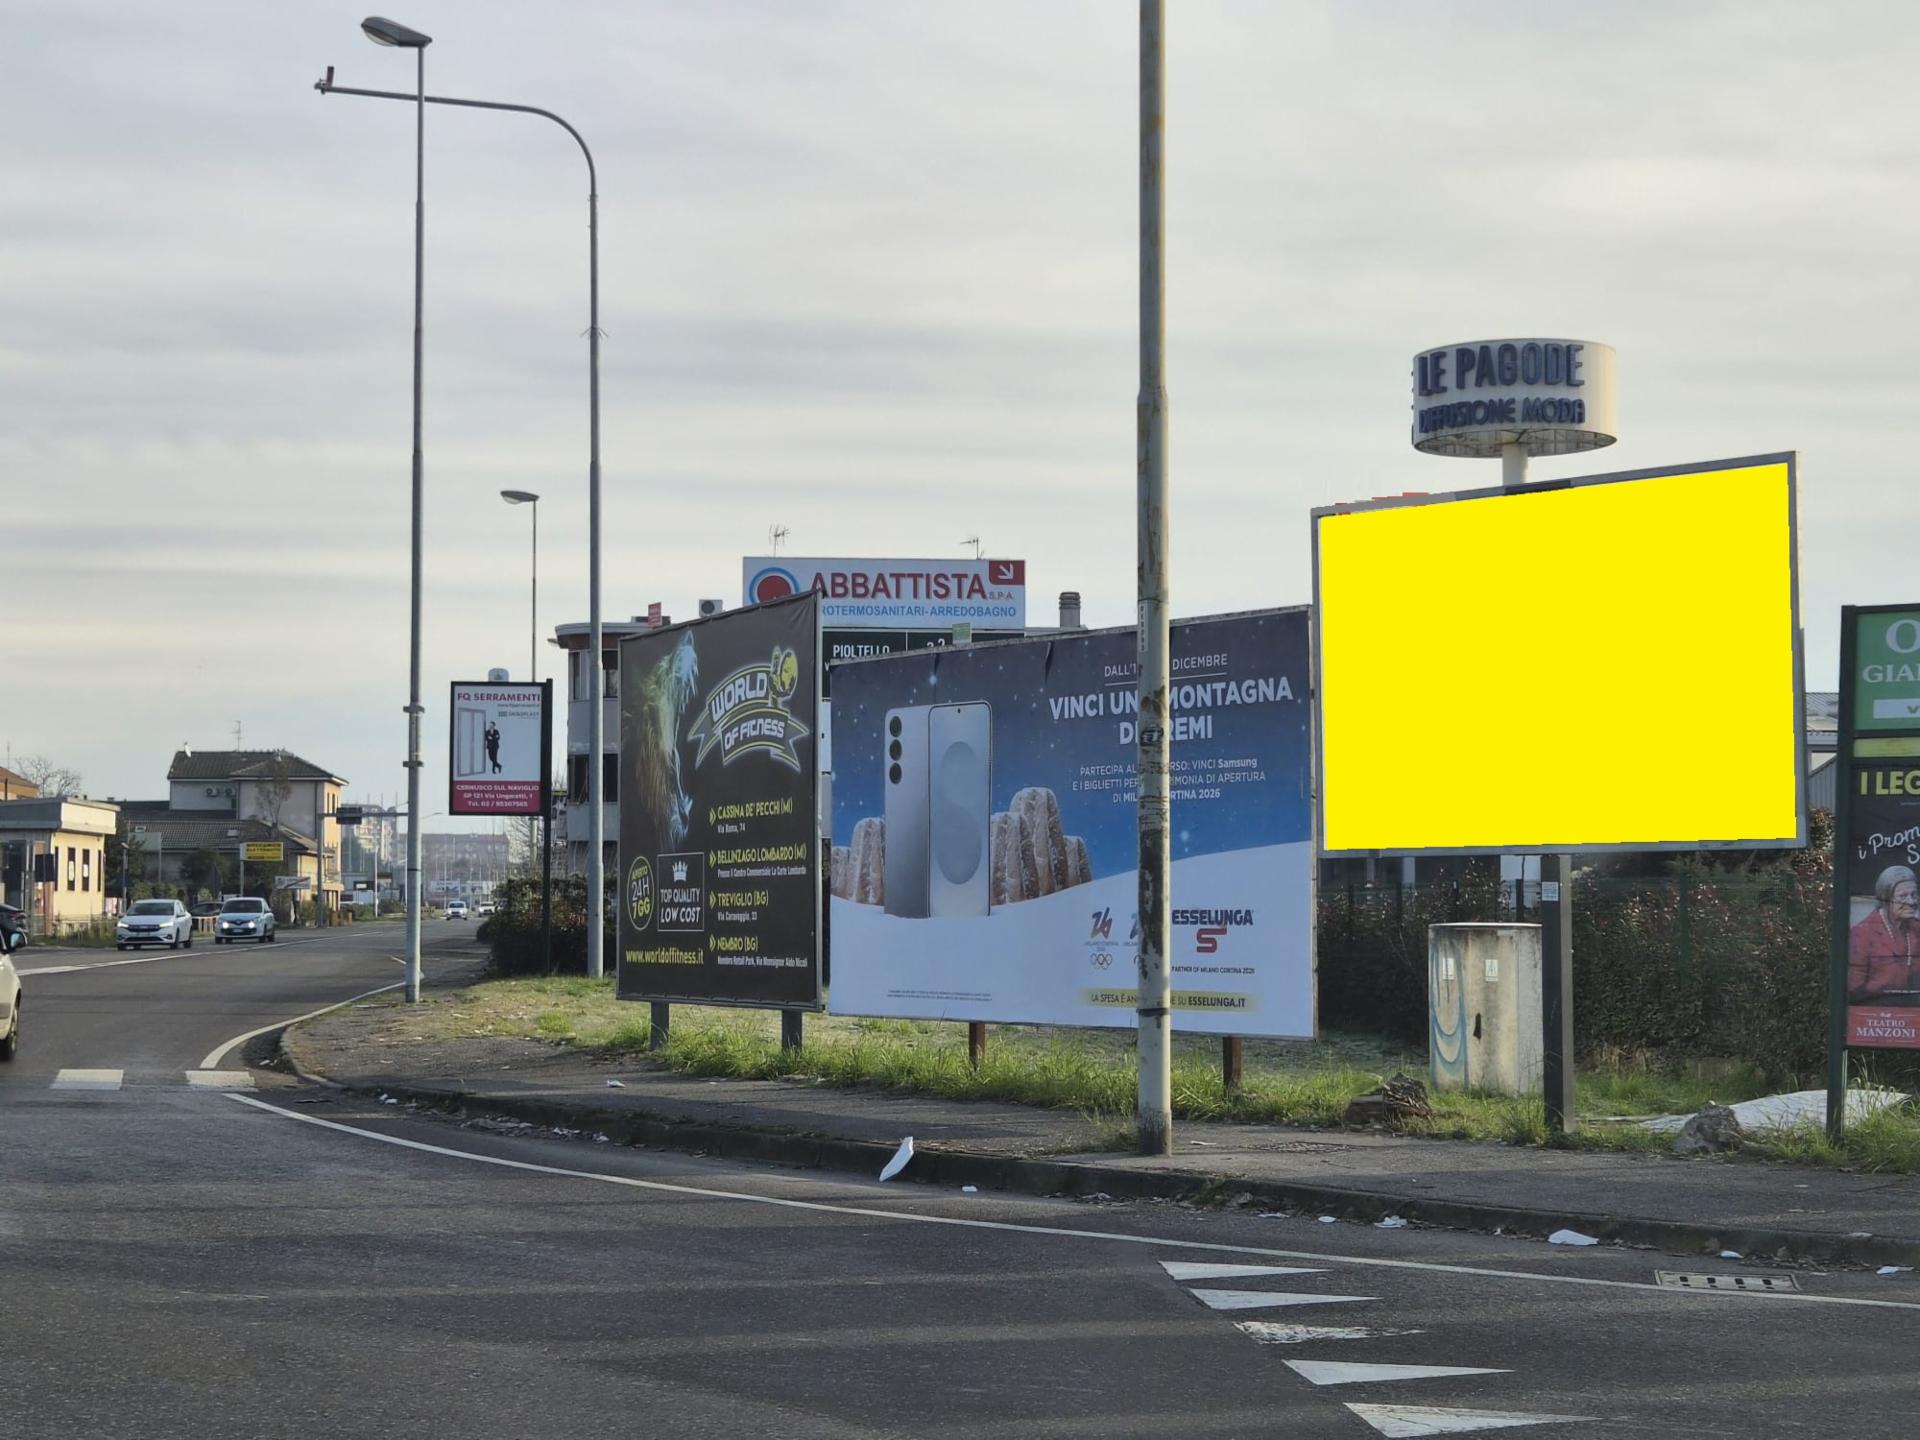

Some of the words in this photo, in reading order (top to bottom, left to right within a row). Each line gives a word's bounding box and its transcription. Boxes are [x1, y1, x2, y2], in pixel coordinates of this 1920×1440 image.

[1418, 351, 1448, 397] LE
[1455, 342, 1585, 390] PAGODE
[1522, 396, 1585, 424] MODA
[811, 572, 987, 600] ABBATTISTA
[822, 604, 1016, 618] ROTERMOSANITARI-ARREDOBAGNO
[1172, 654, 1228, 670] DICEMBRE
[1862, 664, 1920, 683] GIA
[457, 692, 471, 701] FQ
[473, 693, 541, 702] SERRAMENTI
[711, 672, 767, 722] WORLD
[1049, 693, 1104, 720] VINCI
[1110, 689, 1138, 715] UN
[1169, 676, 1293, 711] MONTAGNA
[1169, 715, 1213, 741] REMI
[724, 731, 741, 750] OF
[1080, 765, 1124, 777] PARTECIPA
[1192, 759, 1216, 770] VINCI
[1217, 757, 1258, 770] Samsung
[1084, 778, 1122, 790] BIGLIETTI
[1170, 774, 1204, 786] IMONIA
[1206, 774, 1216, 784] DI
[1218, 771, 1266, 783] APERTURA
[1113, 793, 1122, 803] DI
[1123, 791, 1137, 802] MIL
[1170, 790, 1196, 800] RTINA
[1199, 788, 1220, 799] 2026
[717, 804, 745, 820] CASSINA
[756, 801, 780, 816] PECCHI
[717, 849, 756, 865] BELLINZAGO
[757, 846, 794, 862] LOMBARDO
[631, 876, 650, 901] 24H
[660, 888, 673, 903] TOP
[673, 888, 701, 903] QUALITY
[717, 892, 752, 907] TREVIGLIO
[753, 890, 769, 906] (BG)
[660, 907, 679, 923] LOW
[679, 907, 701, 923] COST
[1172, 909, 1254, 926] ESSELUNGA
[717, 936, 744, 952] NEMBRO
[744, 936, 759, 952] (BG)
[625, 947, 704, 964] www.worldoffitness.it
[1188, 995, 1246, 1008] ESSELUNGA.IT
[1856, 1026, 1916, 1038] MANZONI
